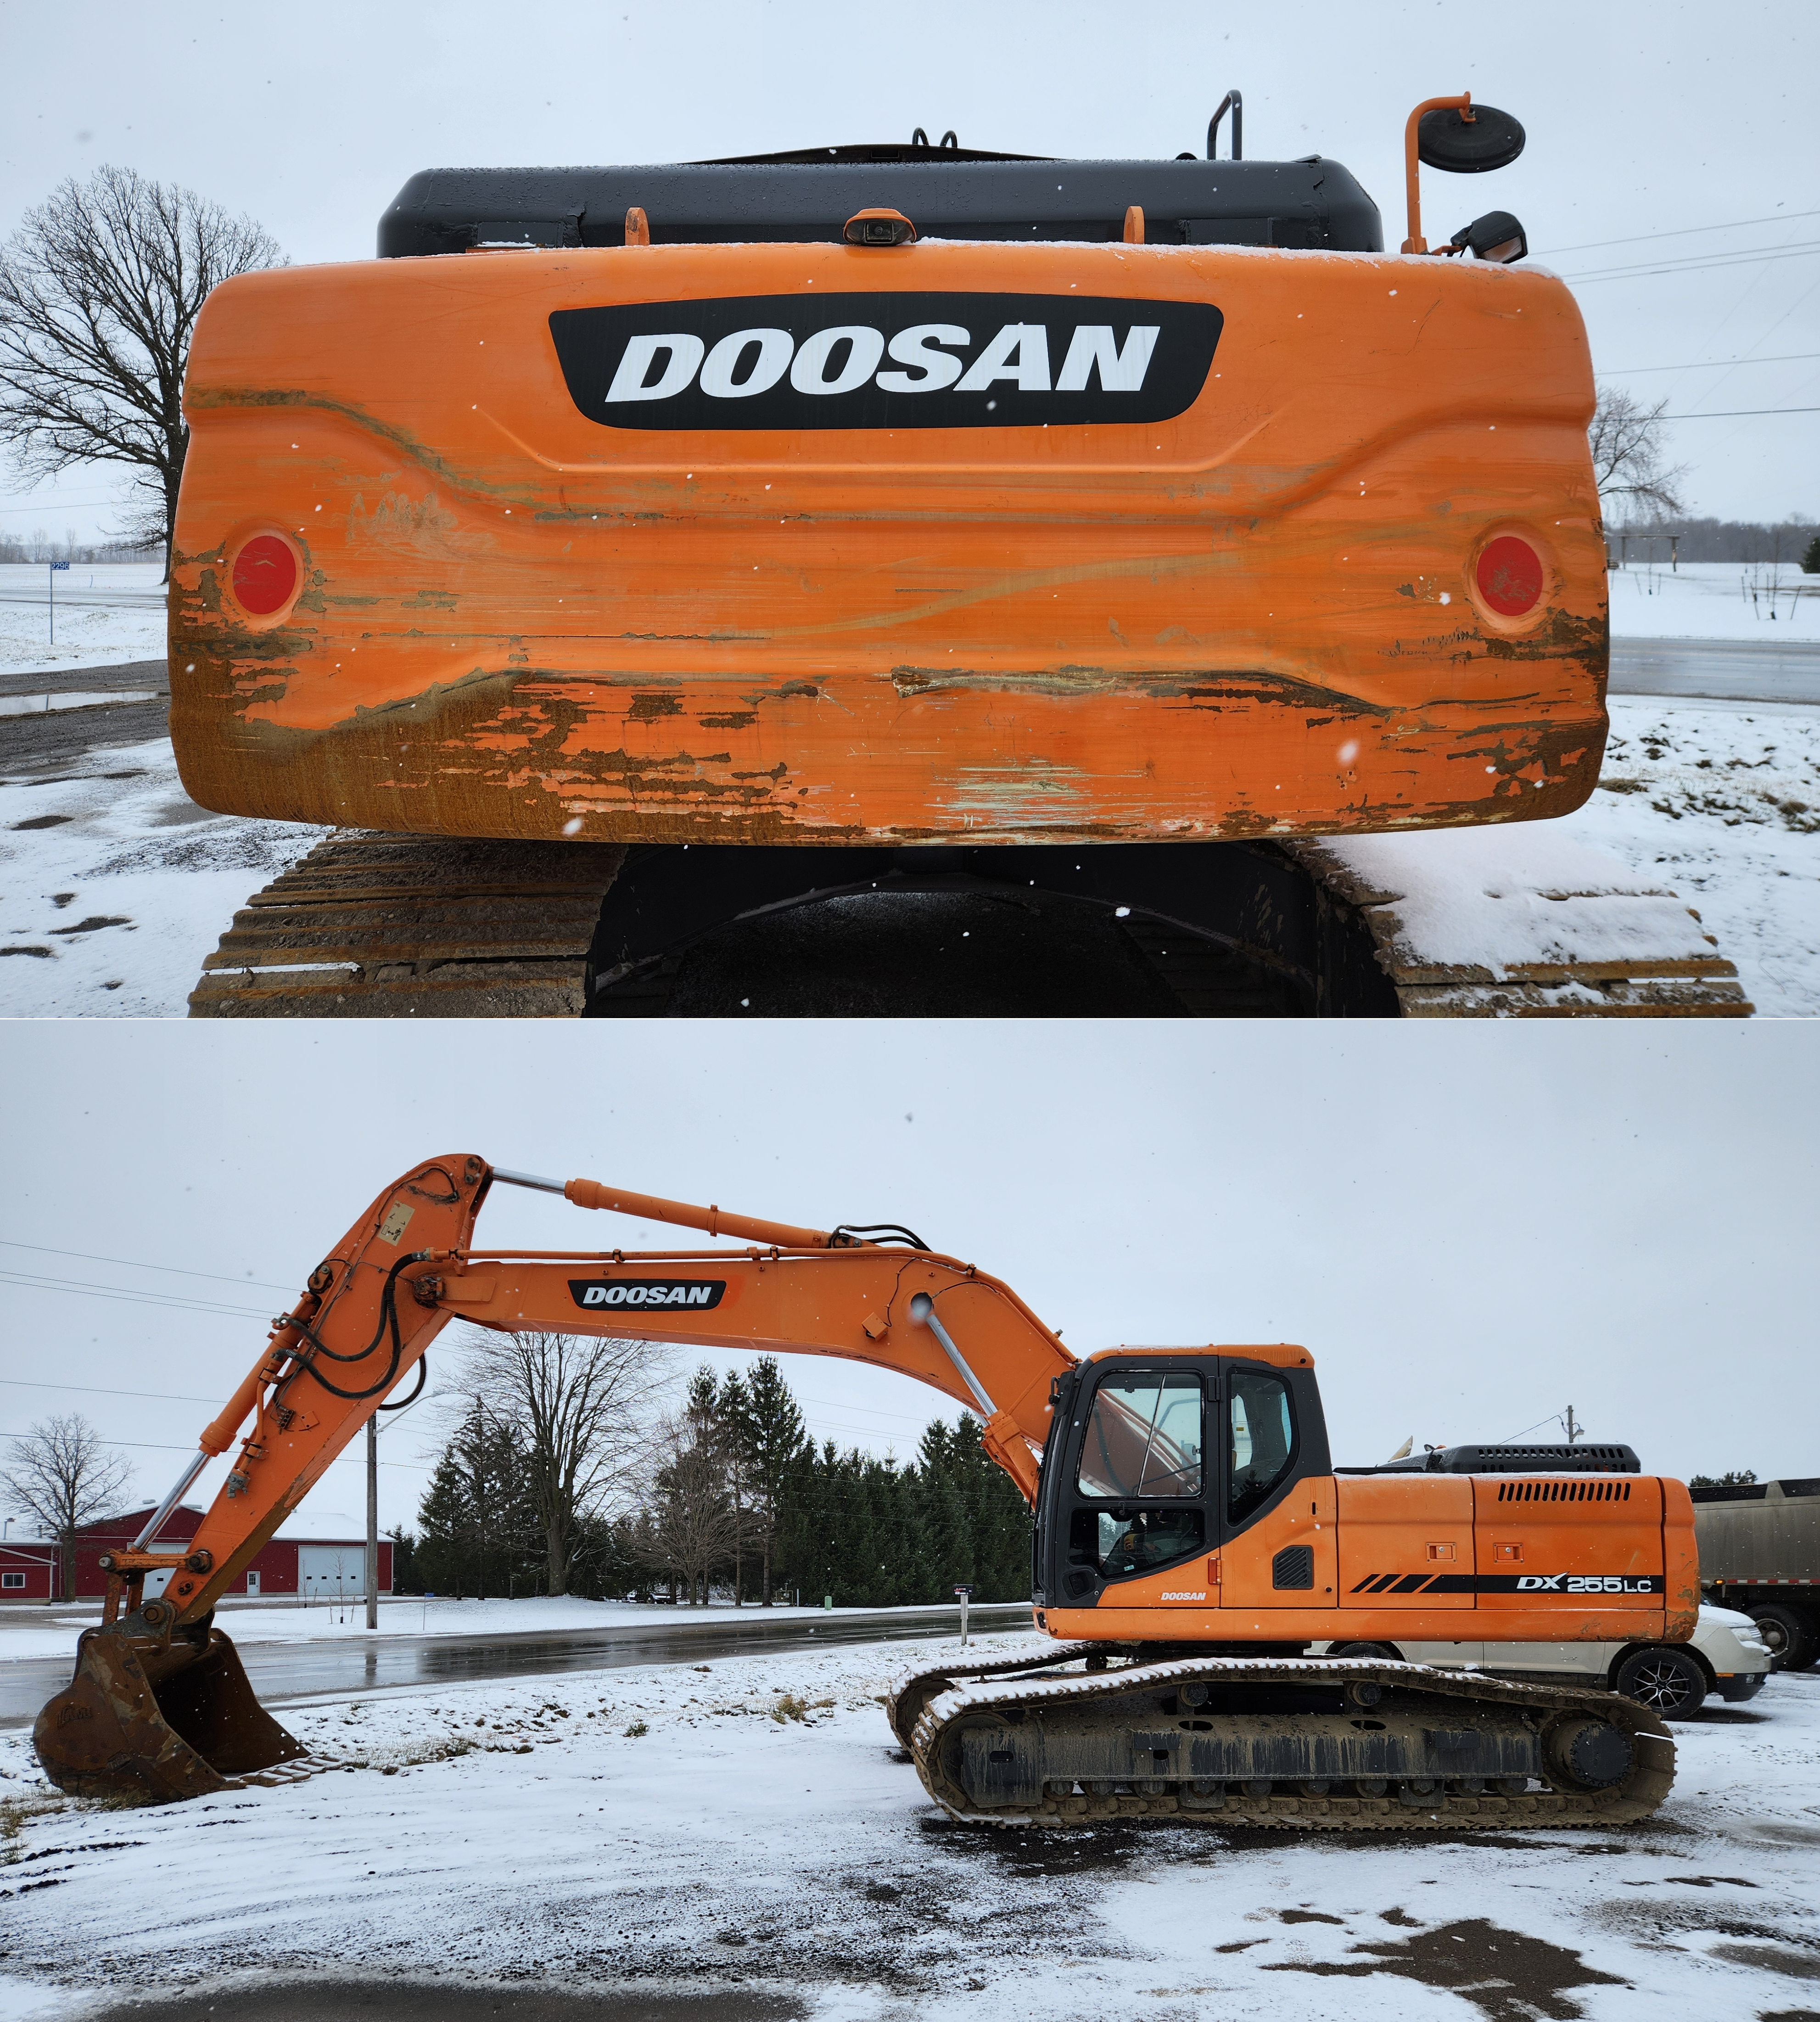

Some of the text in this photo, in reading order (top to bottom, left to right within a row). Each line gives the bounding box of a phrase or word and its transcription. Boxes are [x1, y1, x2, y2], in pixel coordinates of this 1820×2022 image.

[605, 323, 1160, 403] DOOSAN
[582, 1287, 711, 1304] DOOSAN
[1161, 1592, 1206, 1600] DOOSAN
